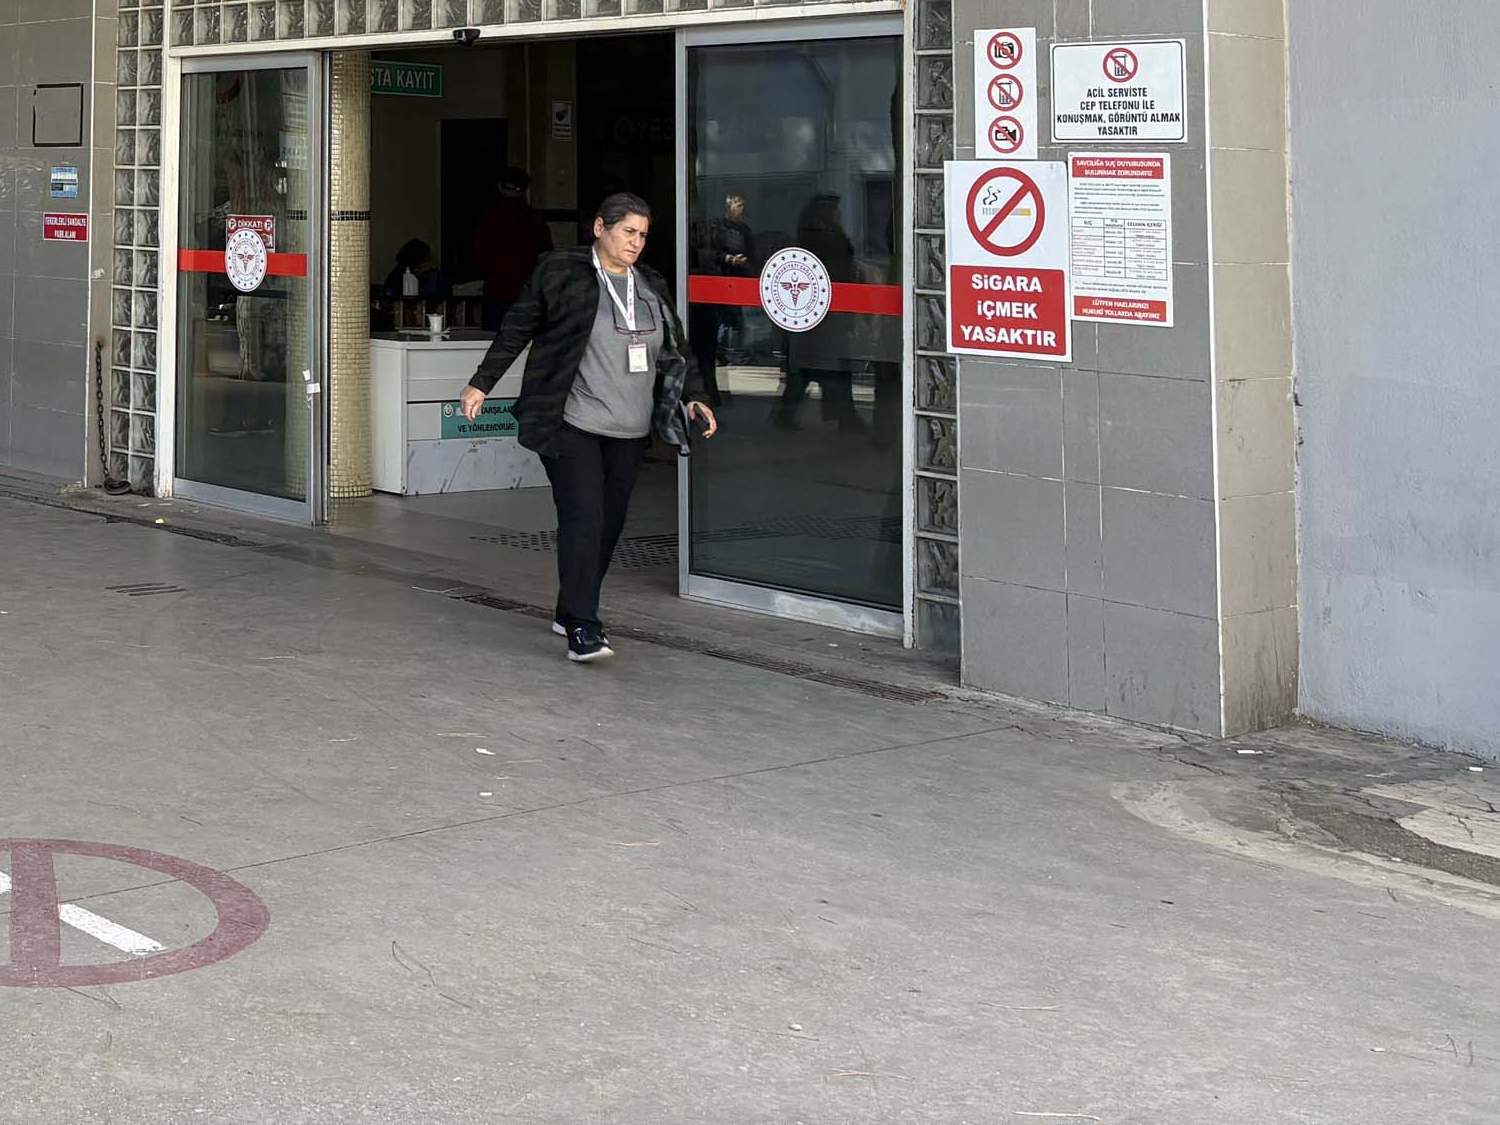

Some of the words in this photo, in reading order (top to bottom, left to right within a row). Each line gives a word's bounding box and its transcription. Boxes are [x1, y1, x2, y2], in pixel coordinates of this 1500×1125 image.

[396, 69, 436, 90] KAYIT
[1086, 86, 1105, 98] ACİL
[1107, 85, 1148, 97] SERVİSTE
[1080, 100, 1096, 111] CEP
[1098, 100, 1140, 111] TELEFONU
[1142, 98, 1155, 110] İLE
[1057, 114, 1106, 125] KONUŞMAK,
[1108, 111, 1148, 123] GÖRÜNTÜ
[1150, 113, 1180, 123] ALMAK
[1097, 126, 1138, 136] YASAKTIR
[960, 324, 1057, 348] YASAKTIR
[457, 424, 468, 432] VE
